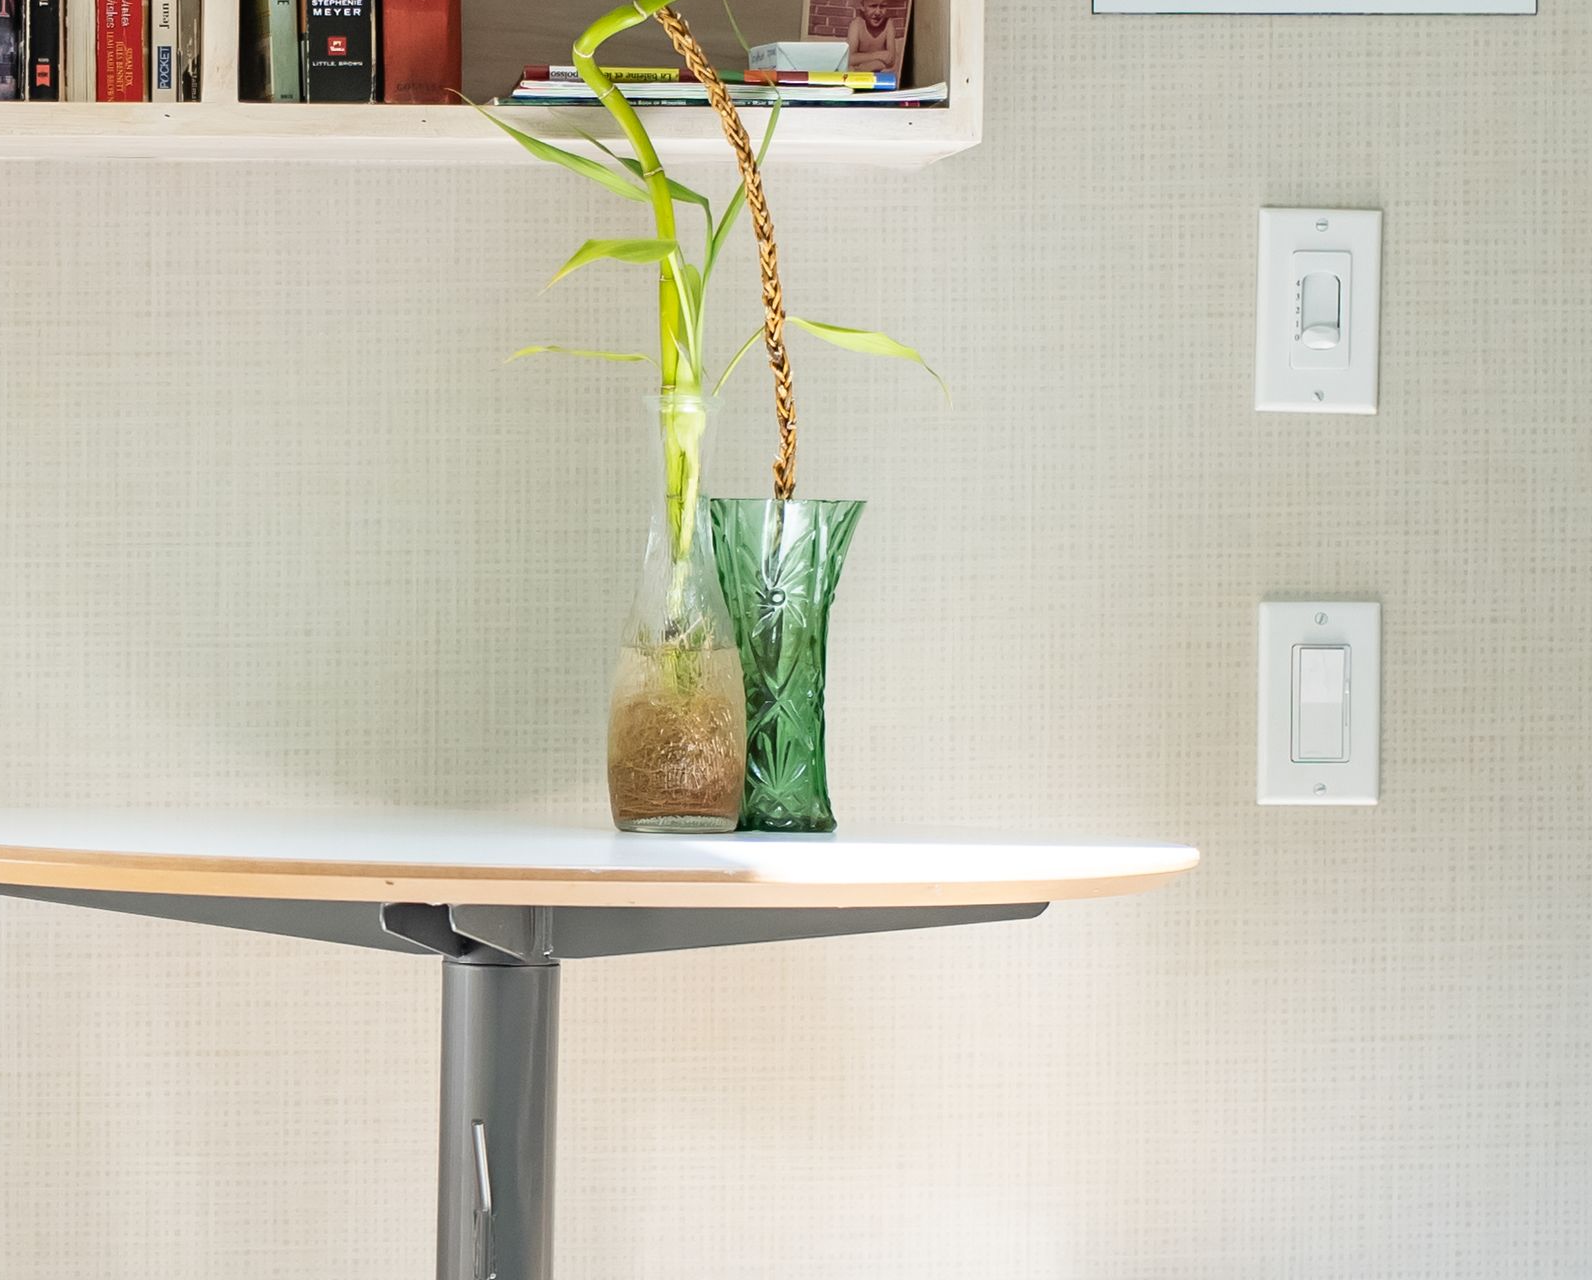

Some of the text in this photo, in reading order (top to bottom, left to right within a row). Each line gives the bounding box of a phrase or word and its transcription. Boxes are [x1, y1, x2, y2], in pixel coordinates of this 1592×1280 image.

[158, 3, 170, 30] Jean
[313, 8, 361, 16] MEYER
[115, 61, 124, 93] BENNETT
[159, 46, 170, 89] POCKET
[660, 73, 672, 82] La
